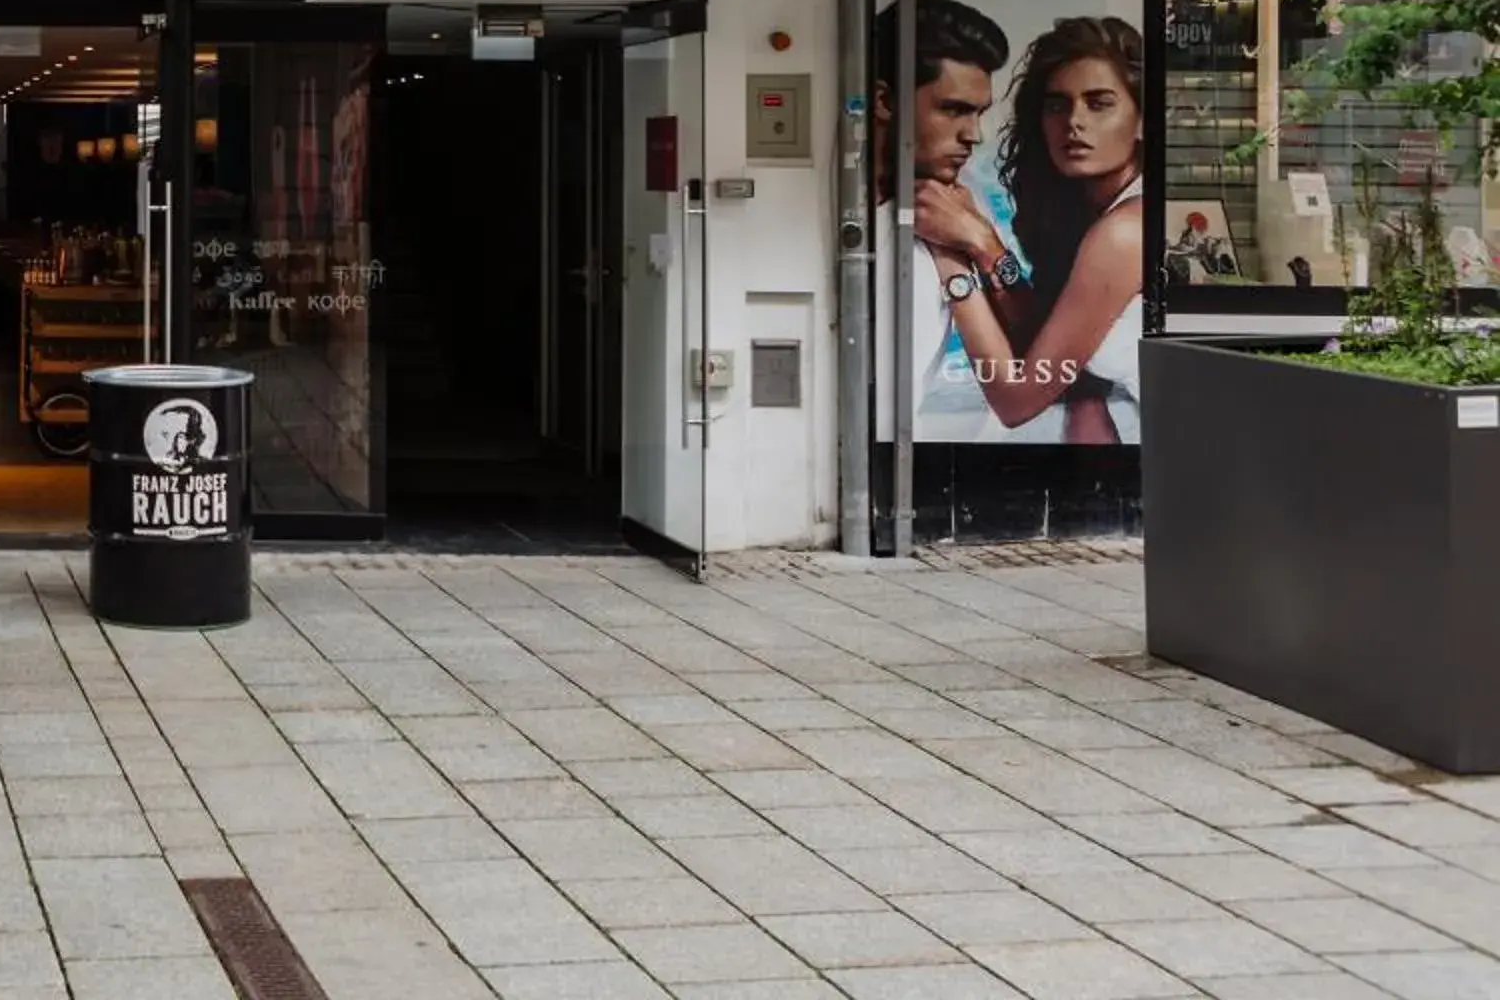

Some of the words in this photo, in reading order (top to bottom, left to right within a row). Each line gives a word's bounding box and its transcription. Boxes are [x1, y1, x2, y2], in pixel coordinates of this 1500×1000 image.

[941, 358, 1079, 384] GUESS
[132, 473, 180, 493] FRANZ
[185, 472, 228, 492] JOSEF
[132, 491, 228, 525] RAUCH
